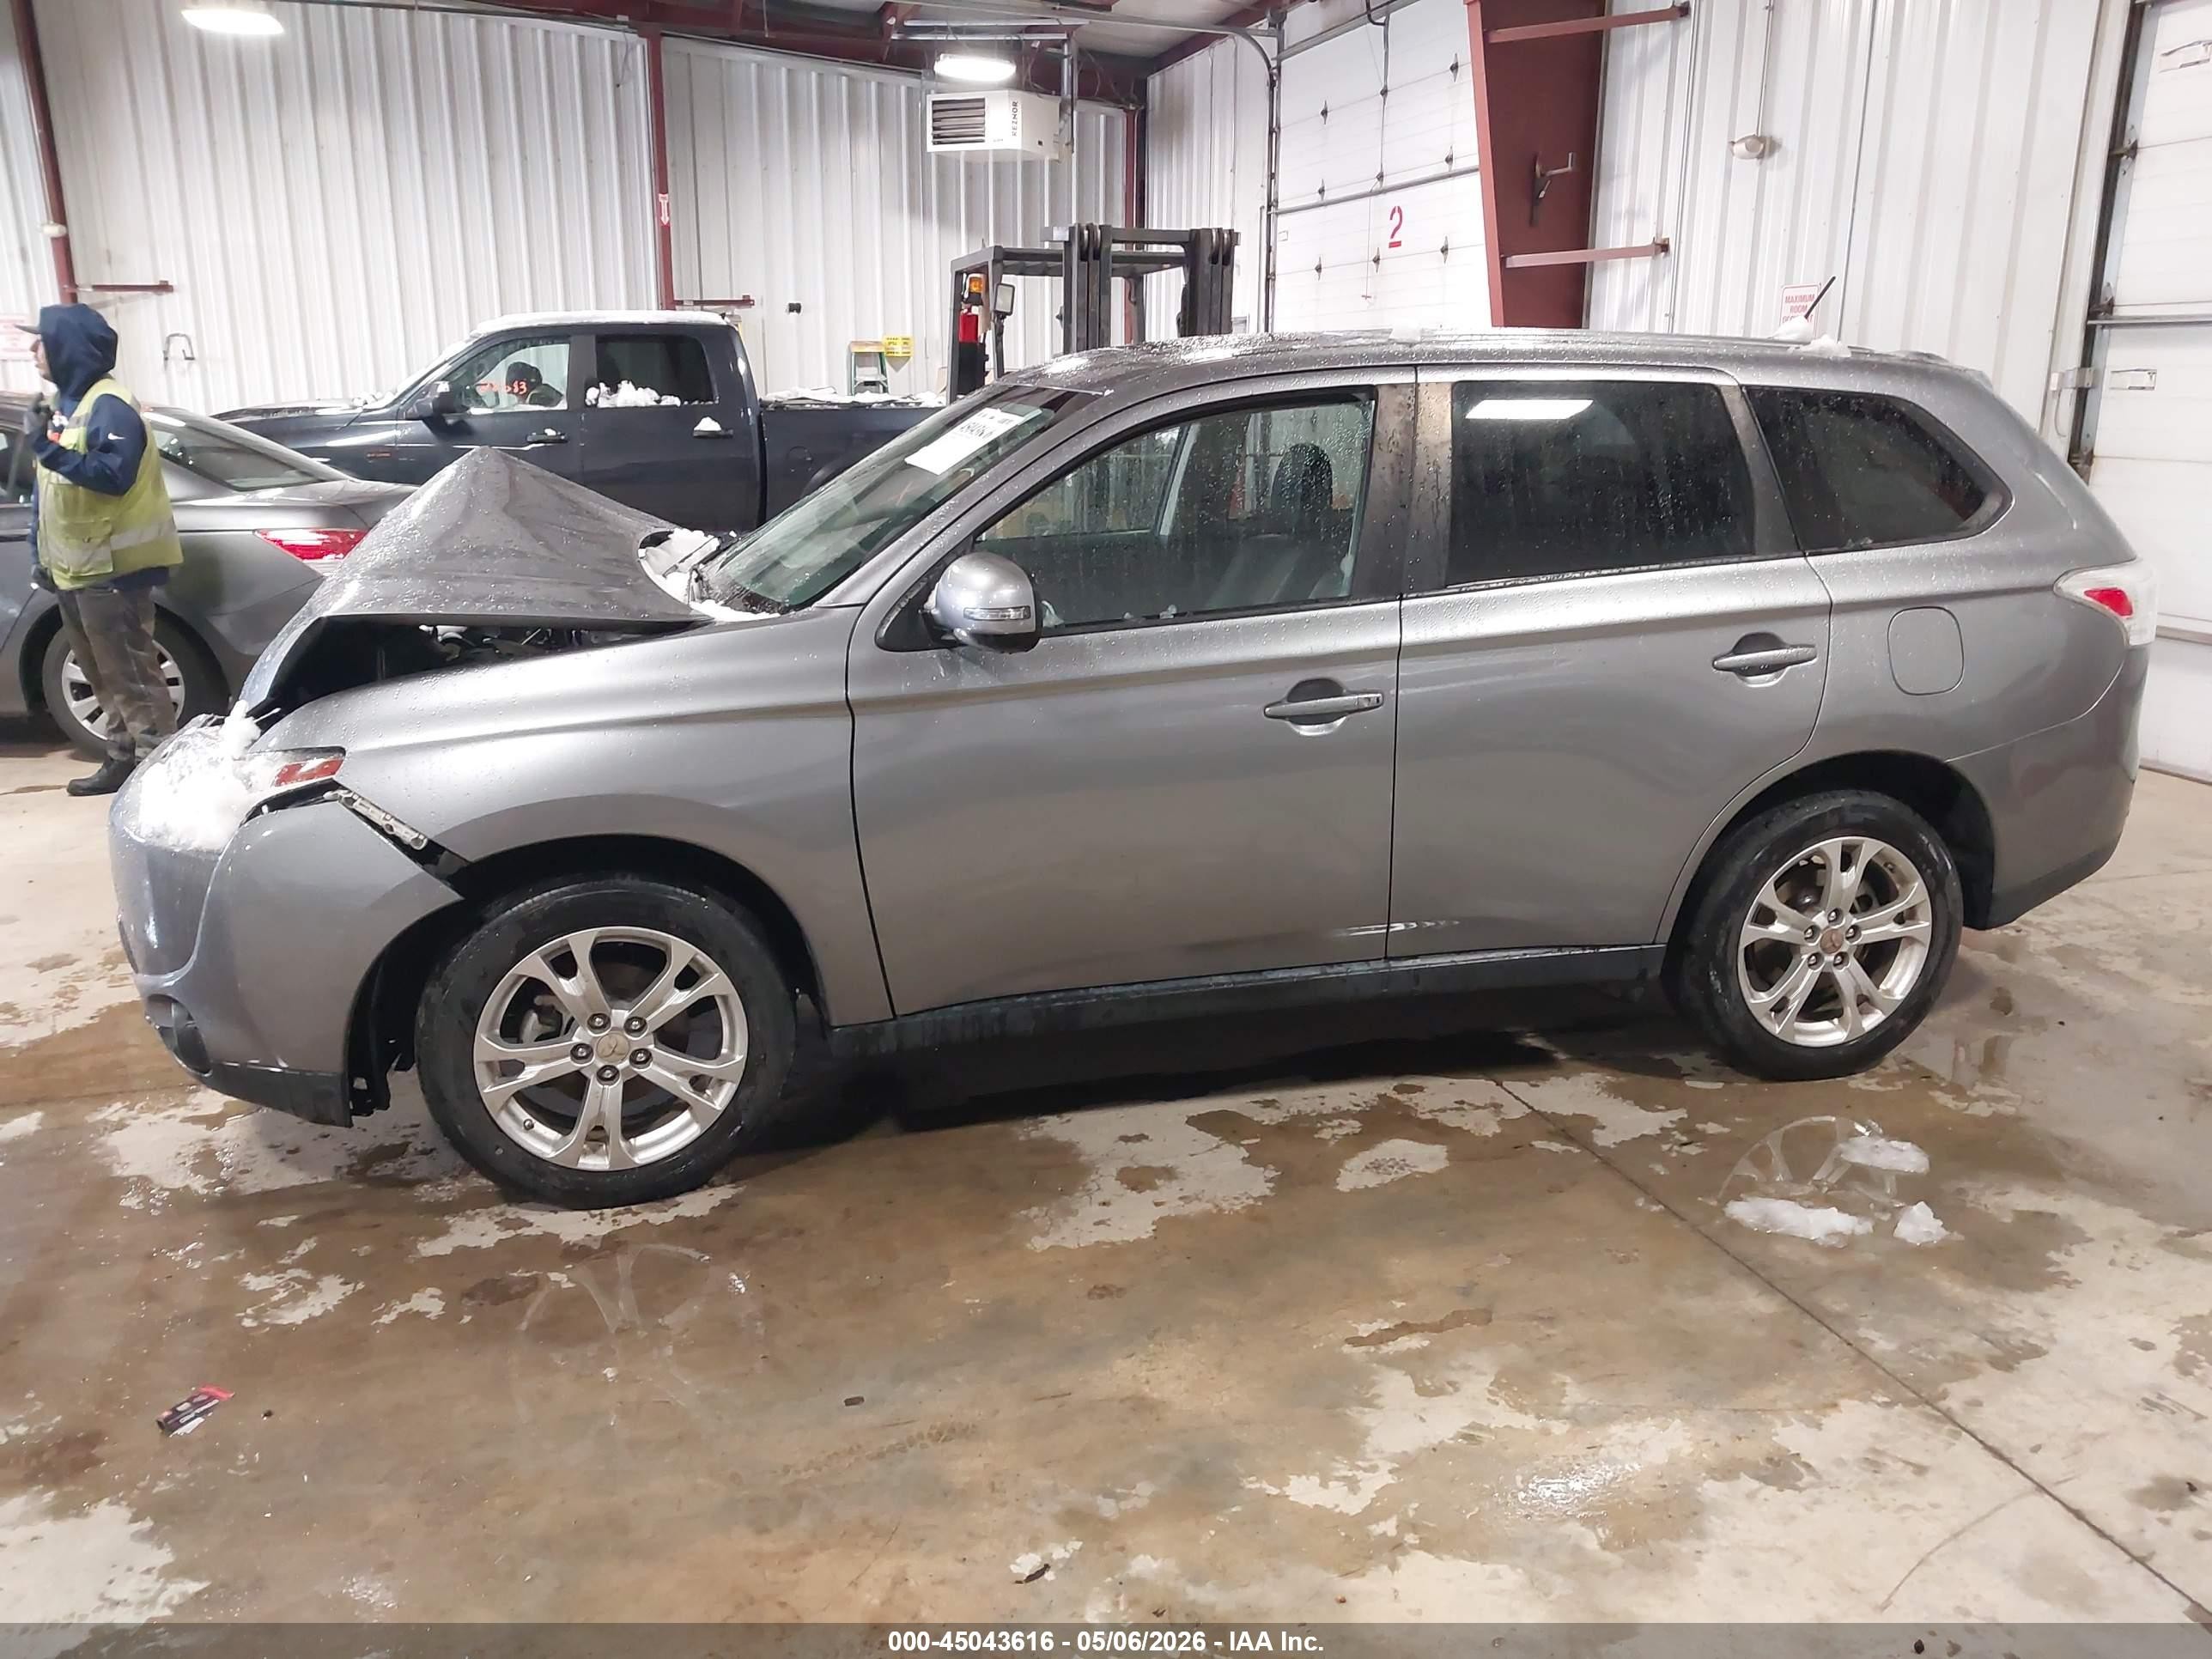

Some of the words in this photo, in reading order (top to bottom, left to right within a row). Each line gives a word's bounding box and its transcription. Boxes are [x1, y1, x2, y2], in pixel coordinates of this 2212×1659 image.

[1389, 205, 1403, 248] 2
[1785, 294, 1815, 303] MAXIMUM
[1790, 304, 1808, 314] ROOM
